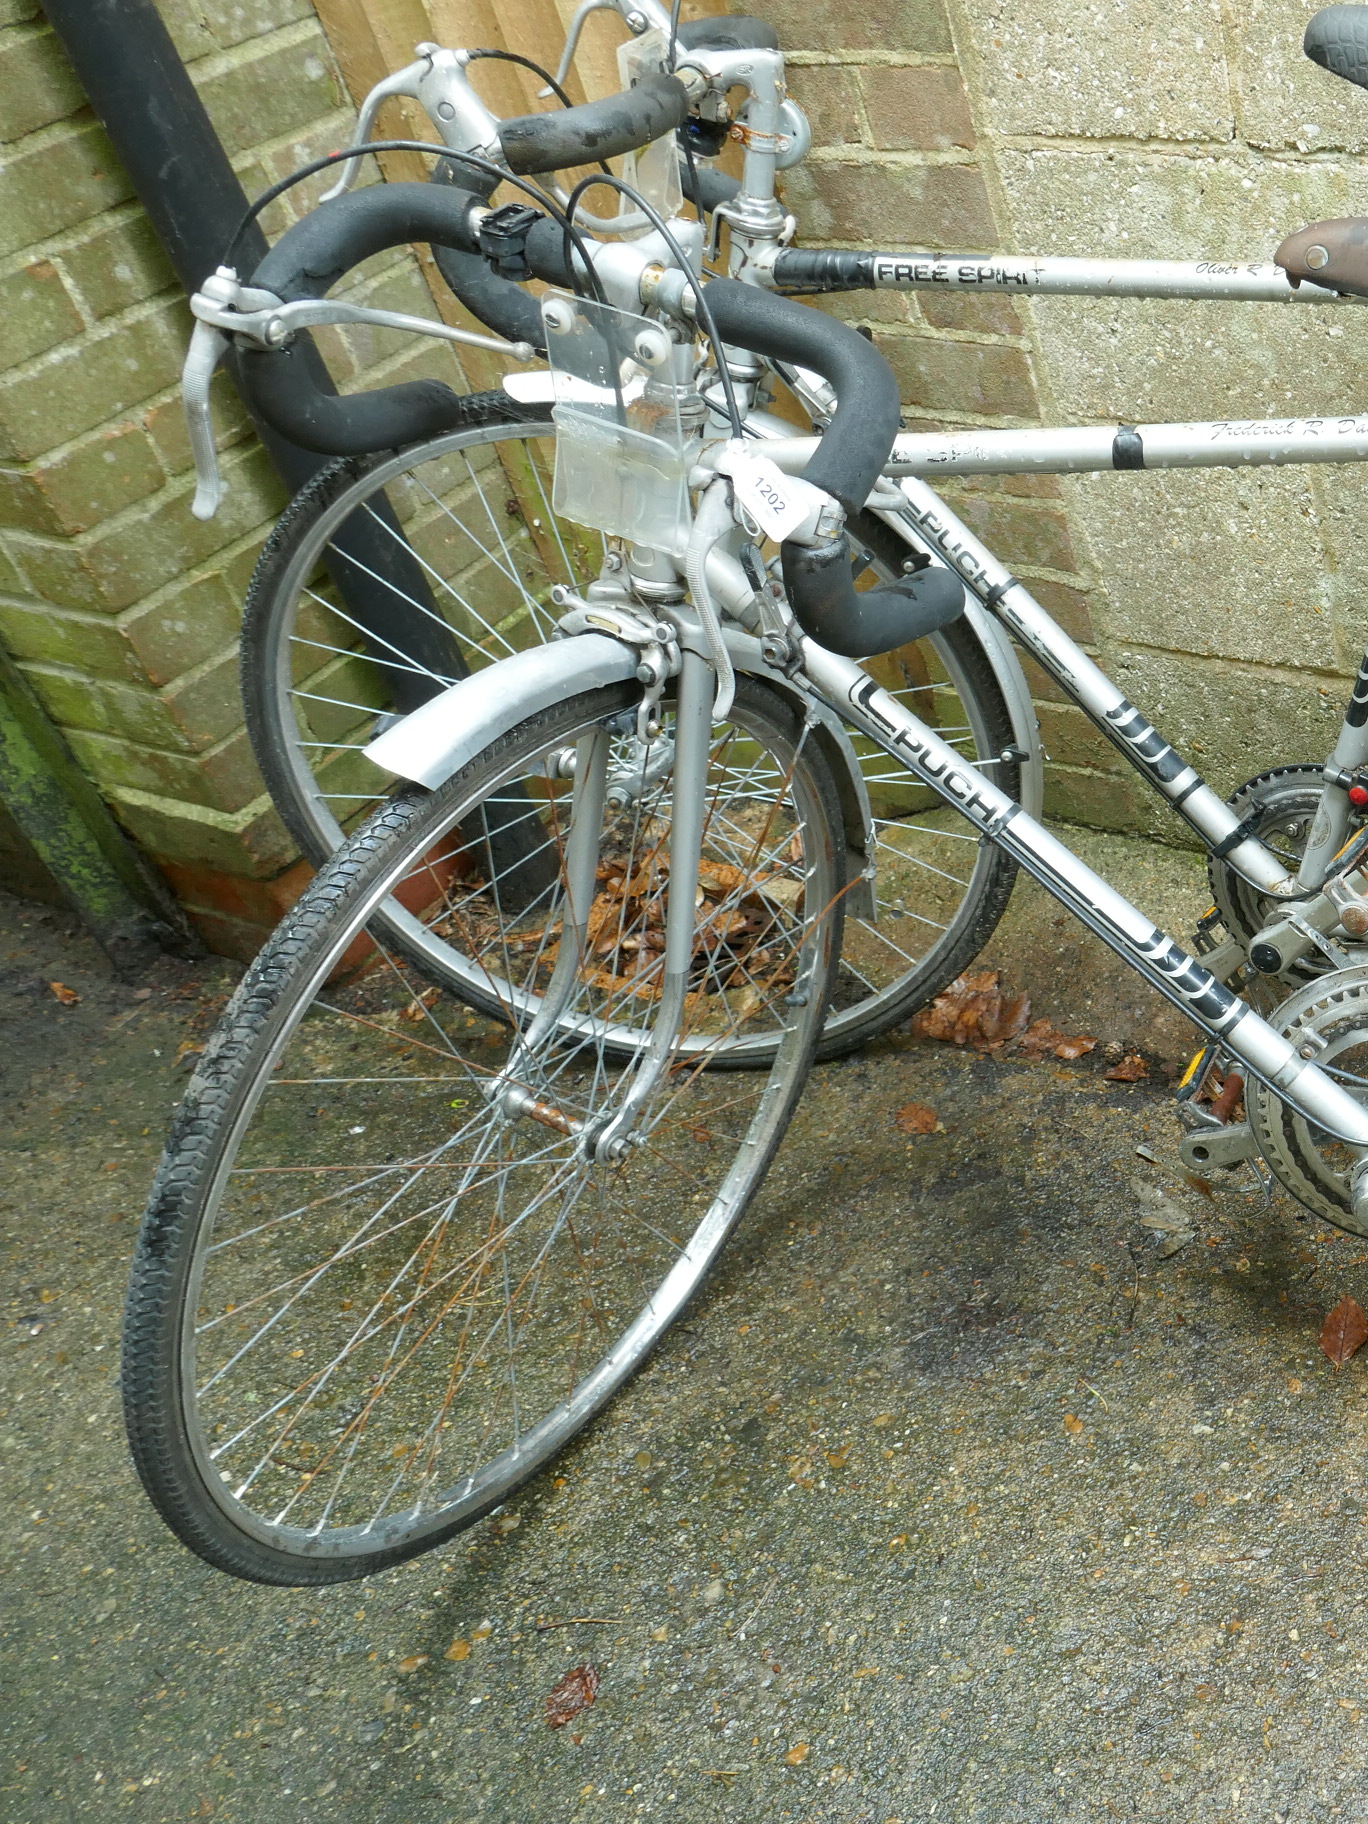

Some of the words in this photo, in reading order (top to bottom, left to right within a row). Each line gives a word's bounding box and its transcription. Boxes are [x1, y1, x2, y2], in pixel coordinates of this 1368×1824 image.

[878, 263, 949, 282] FREE
[1196, 262, 1238, 275] Oliver
[1211, 420, 1296, 441] Frederick
[755, 476, 786, 515] 1202
[894, 725, 1000, 824] PUCH
